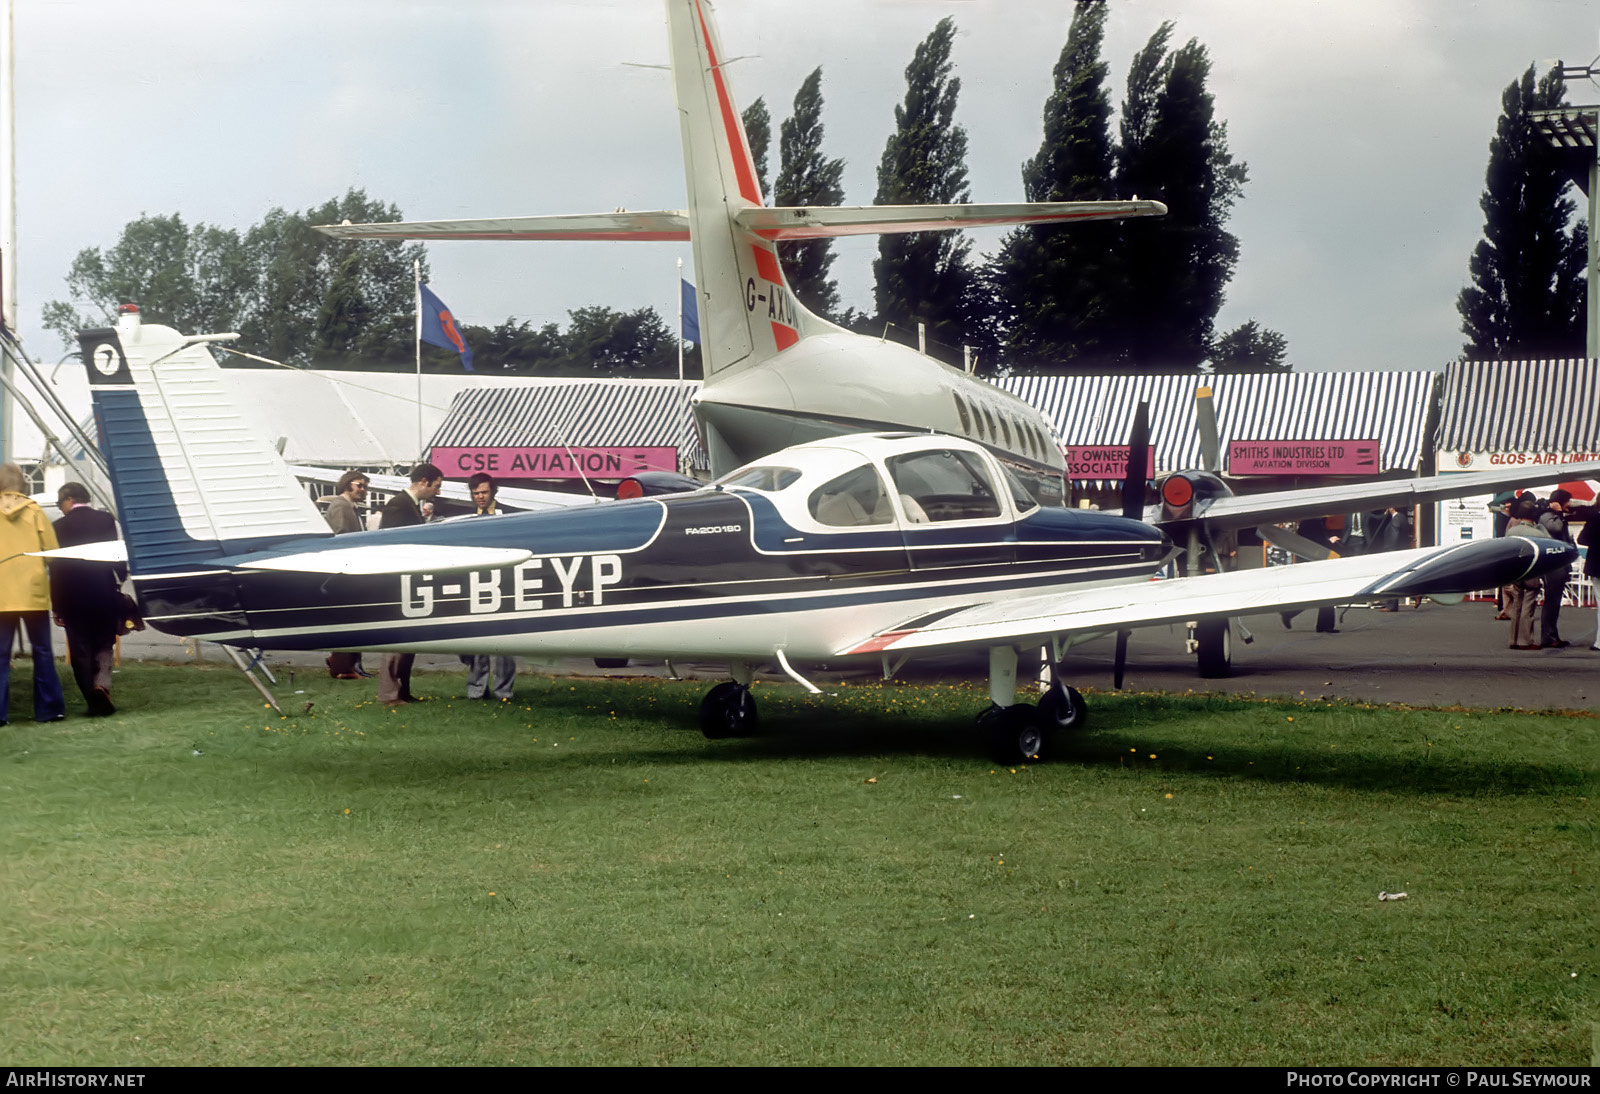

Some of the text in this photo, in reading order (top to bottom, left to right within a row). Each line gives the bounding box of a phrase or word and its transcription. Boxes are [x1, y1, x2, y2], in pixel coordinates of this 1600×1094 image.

[1233, 446, 1345, 459] SMITHS INDUSTRIES LTD
[457, 453, 621, 472] CSE AVIATION
[1253, 460, 1330, 468] AVIATION DIVISION
[1489, 453, 1557, 465] GLOS-AIR
[1546, 546, 1565, 554] FUJI
[401, 554, 622, 618] G-BEYP
